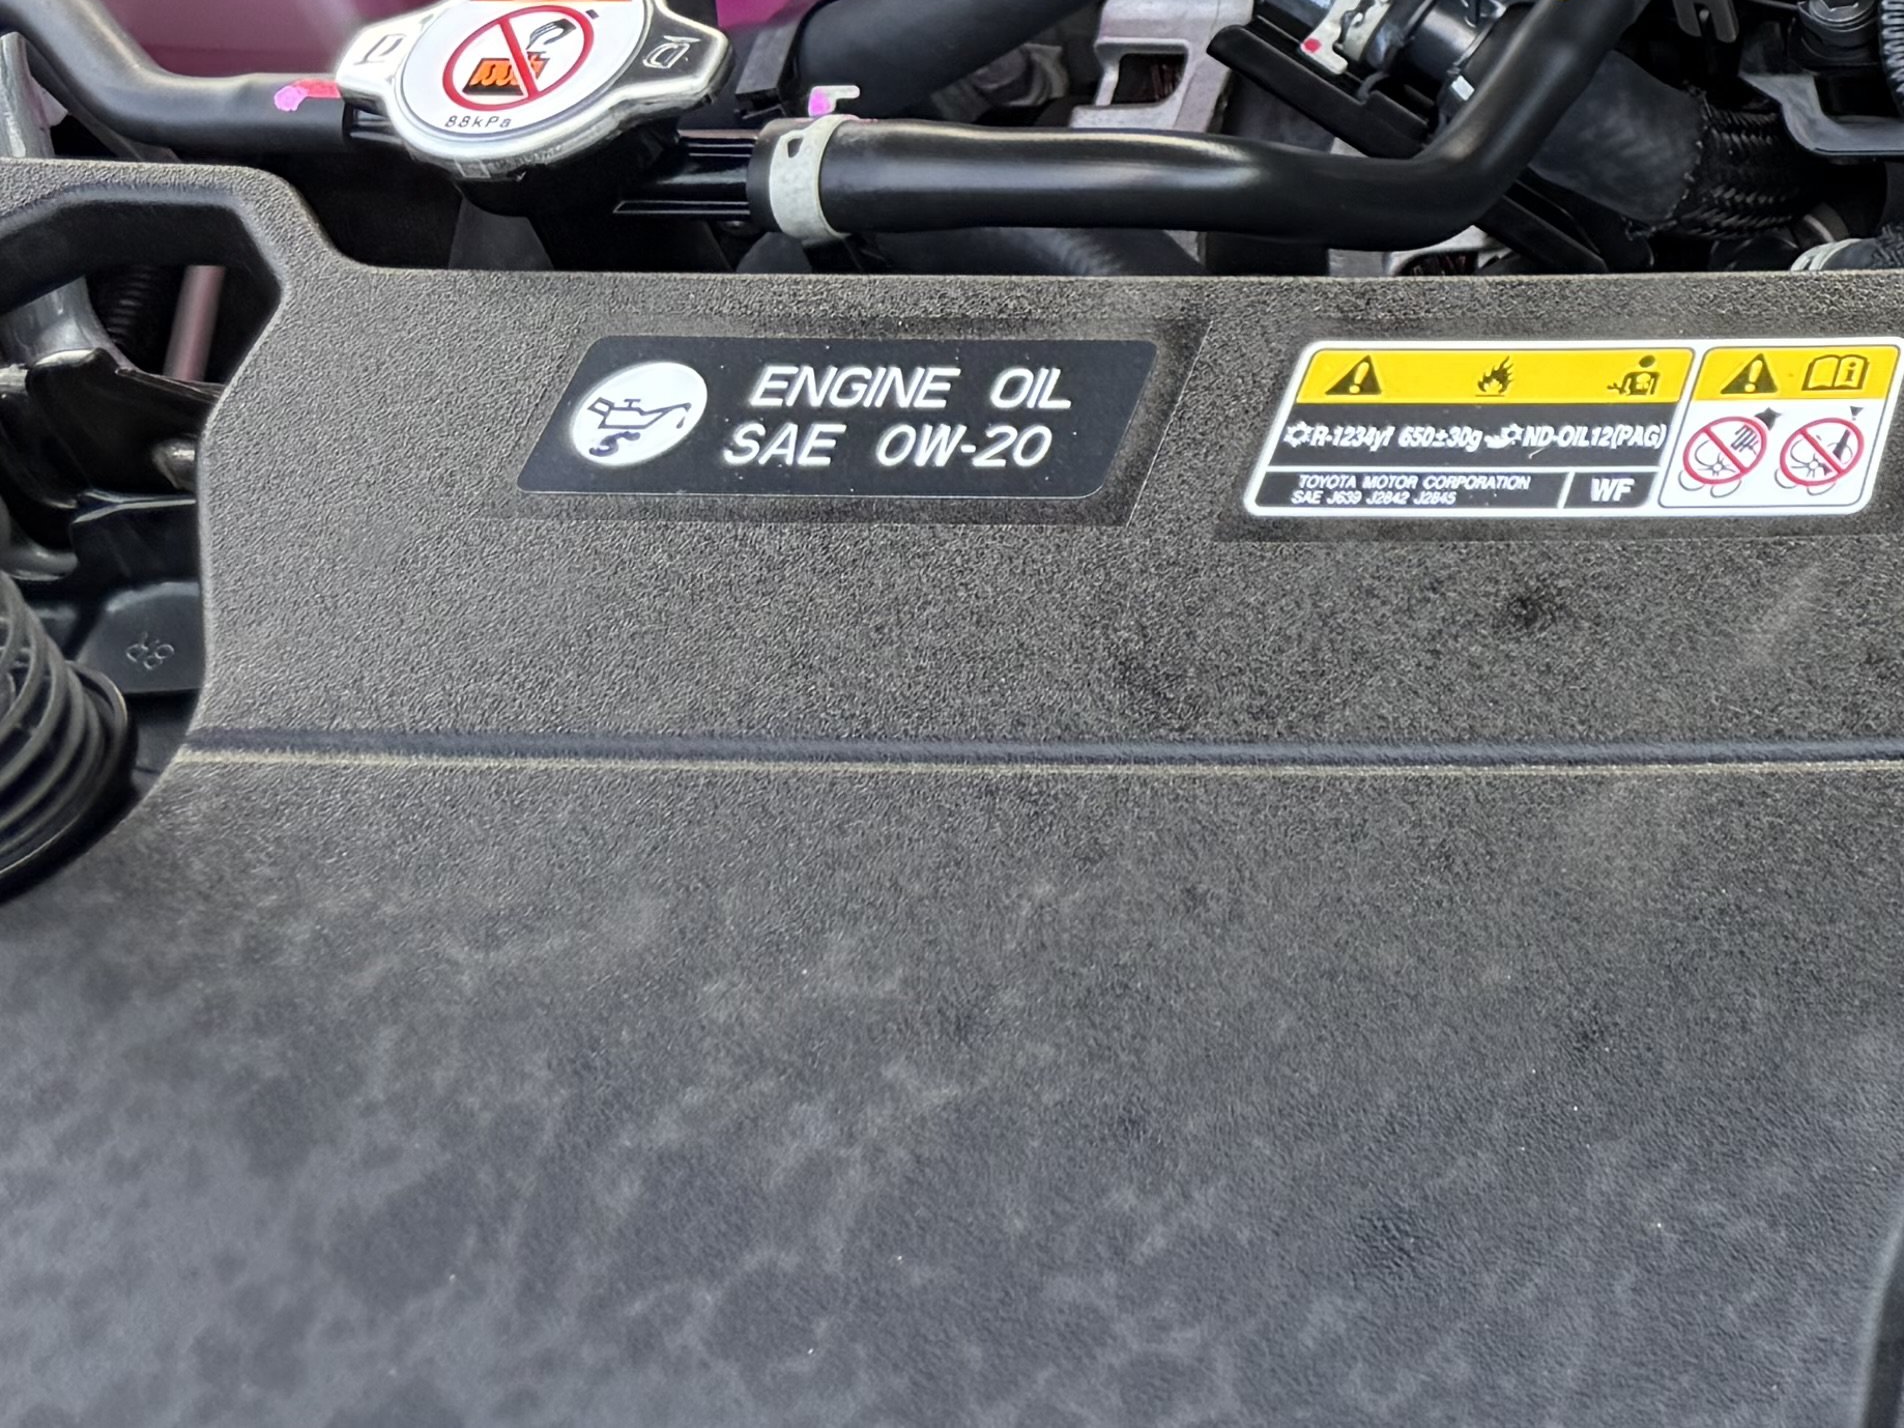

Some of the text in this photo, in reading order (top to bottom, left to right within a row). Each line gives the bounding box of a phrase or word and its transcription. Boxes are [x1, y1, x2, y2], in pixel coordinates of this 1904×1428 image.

[444, 115, 512, 129] 88kPa
[750, 366, 1073, 410] ENGINE OIL
[723, 423, 1054, 469] SAE 0W-20
[1290, 490, 1457, 506] SAE J639 J2842 J2845
[1298, 473, 1636, 502] TOYOTA MOTOR CORPORATION WF
